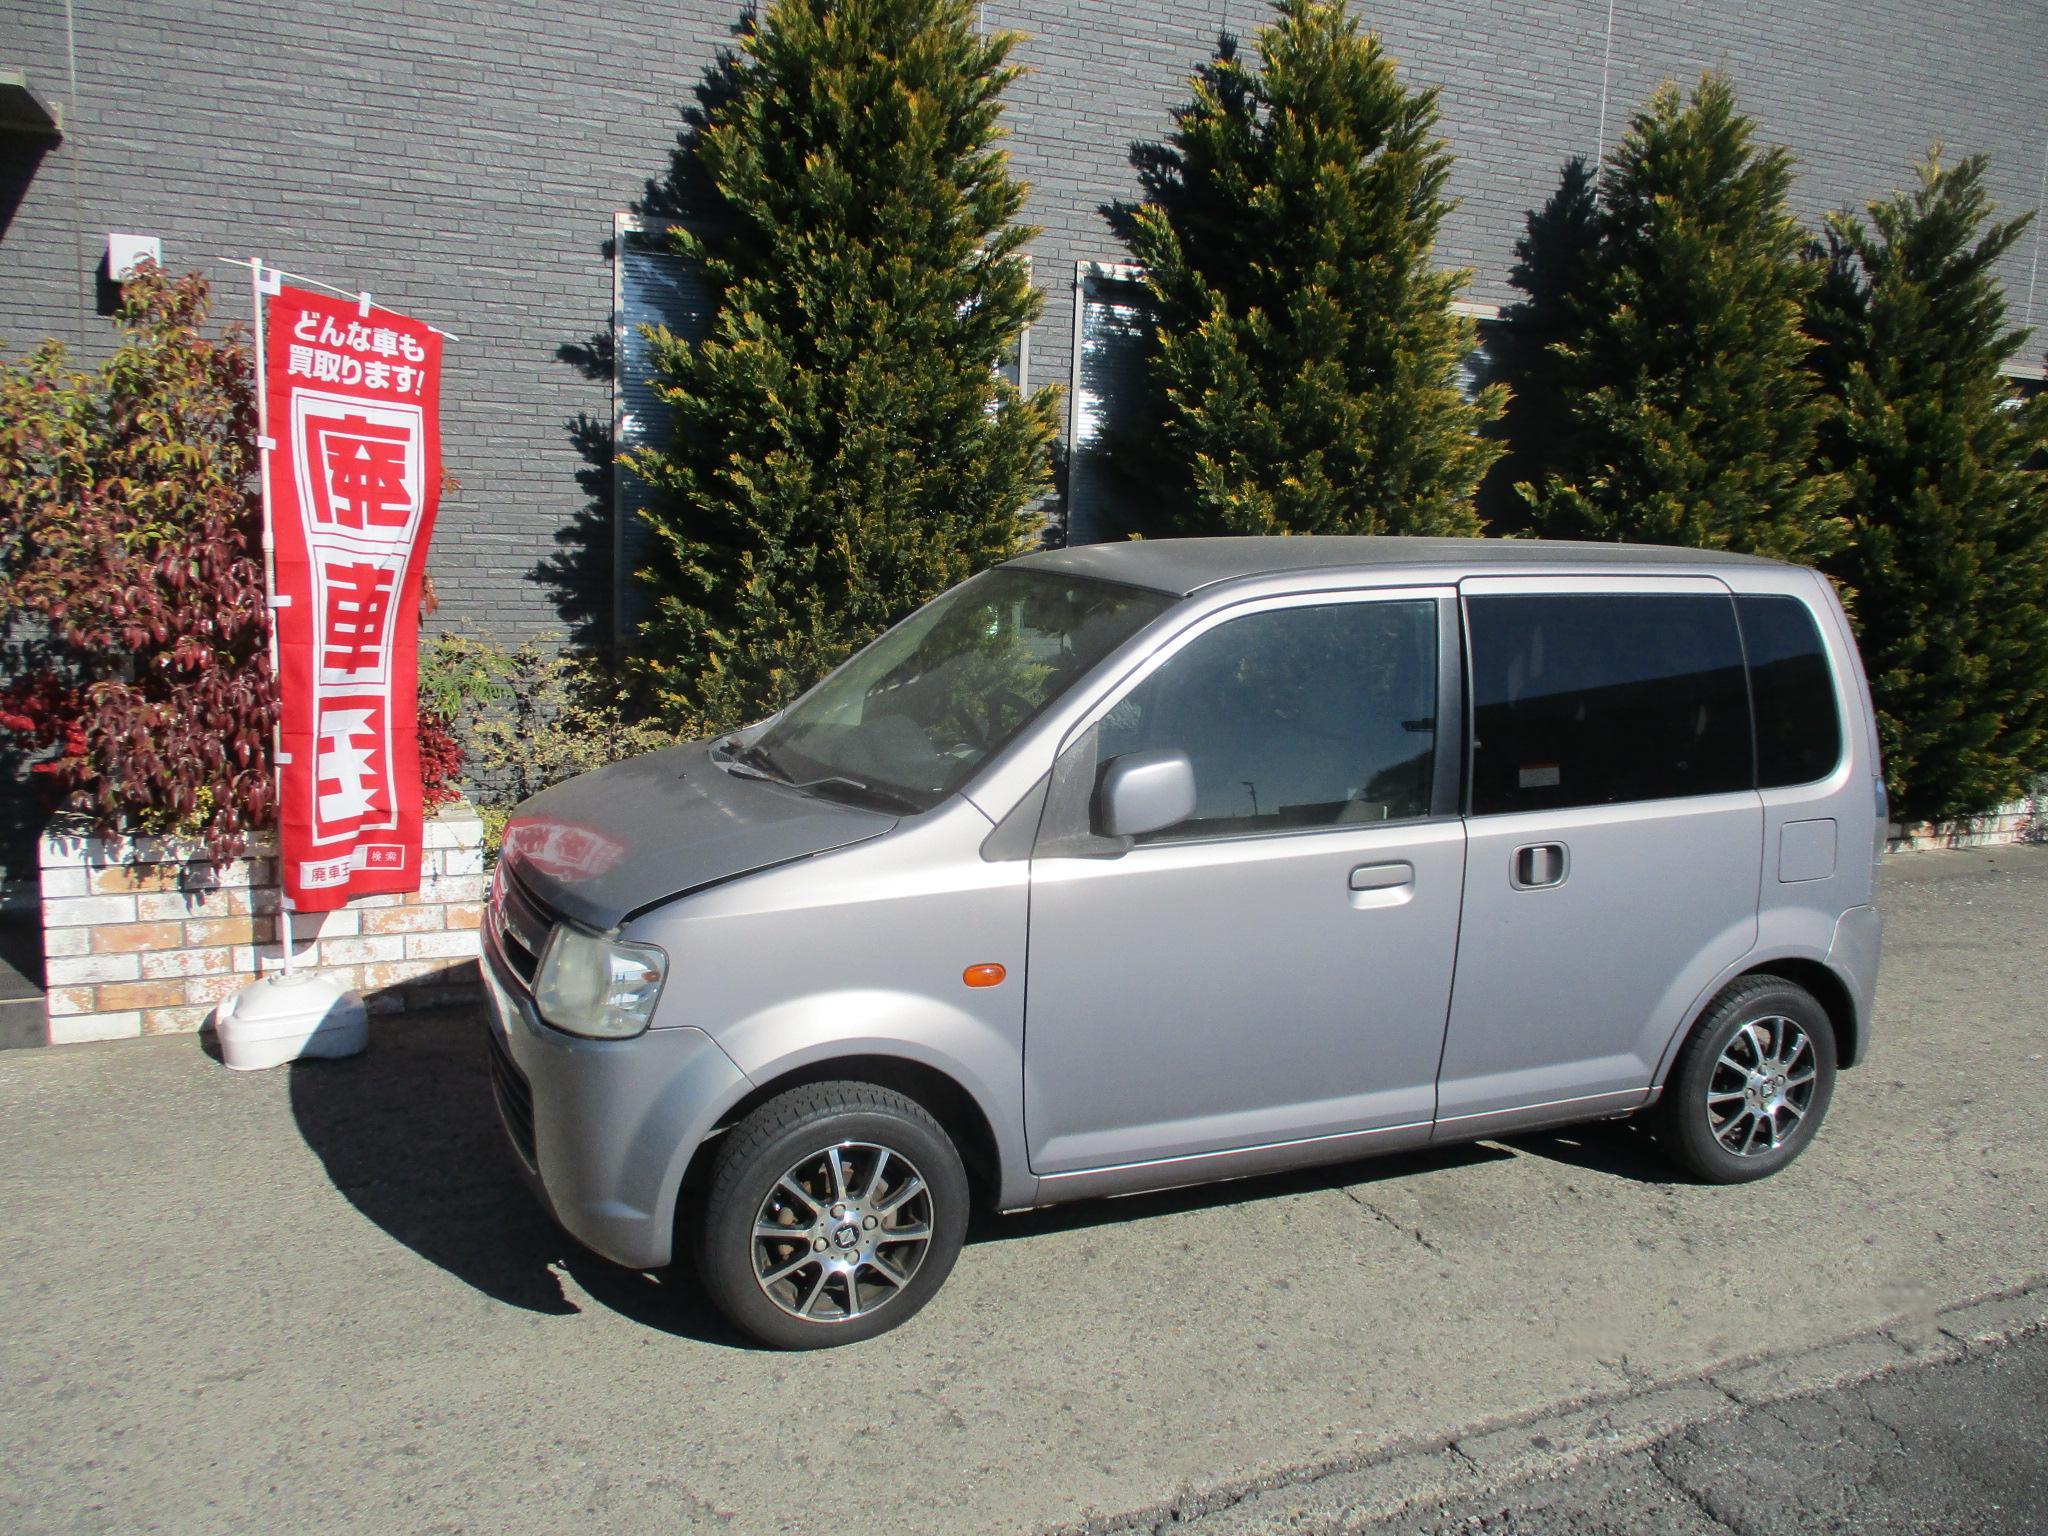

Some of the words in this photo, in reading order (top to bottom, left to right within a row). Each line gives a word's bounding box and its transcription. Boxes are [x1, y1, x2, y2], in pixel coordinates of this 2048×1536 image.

[294, 310, 425, 362] どんな車も
[287, 344, 425, 396] 買取ります!
[304, 411, 414, 824] 廃車王
